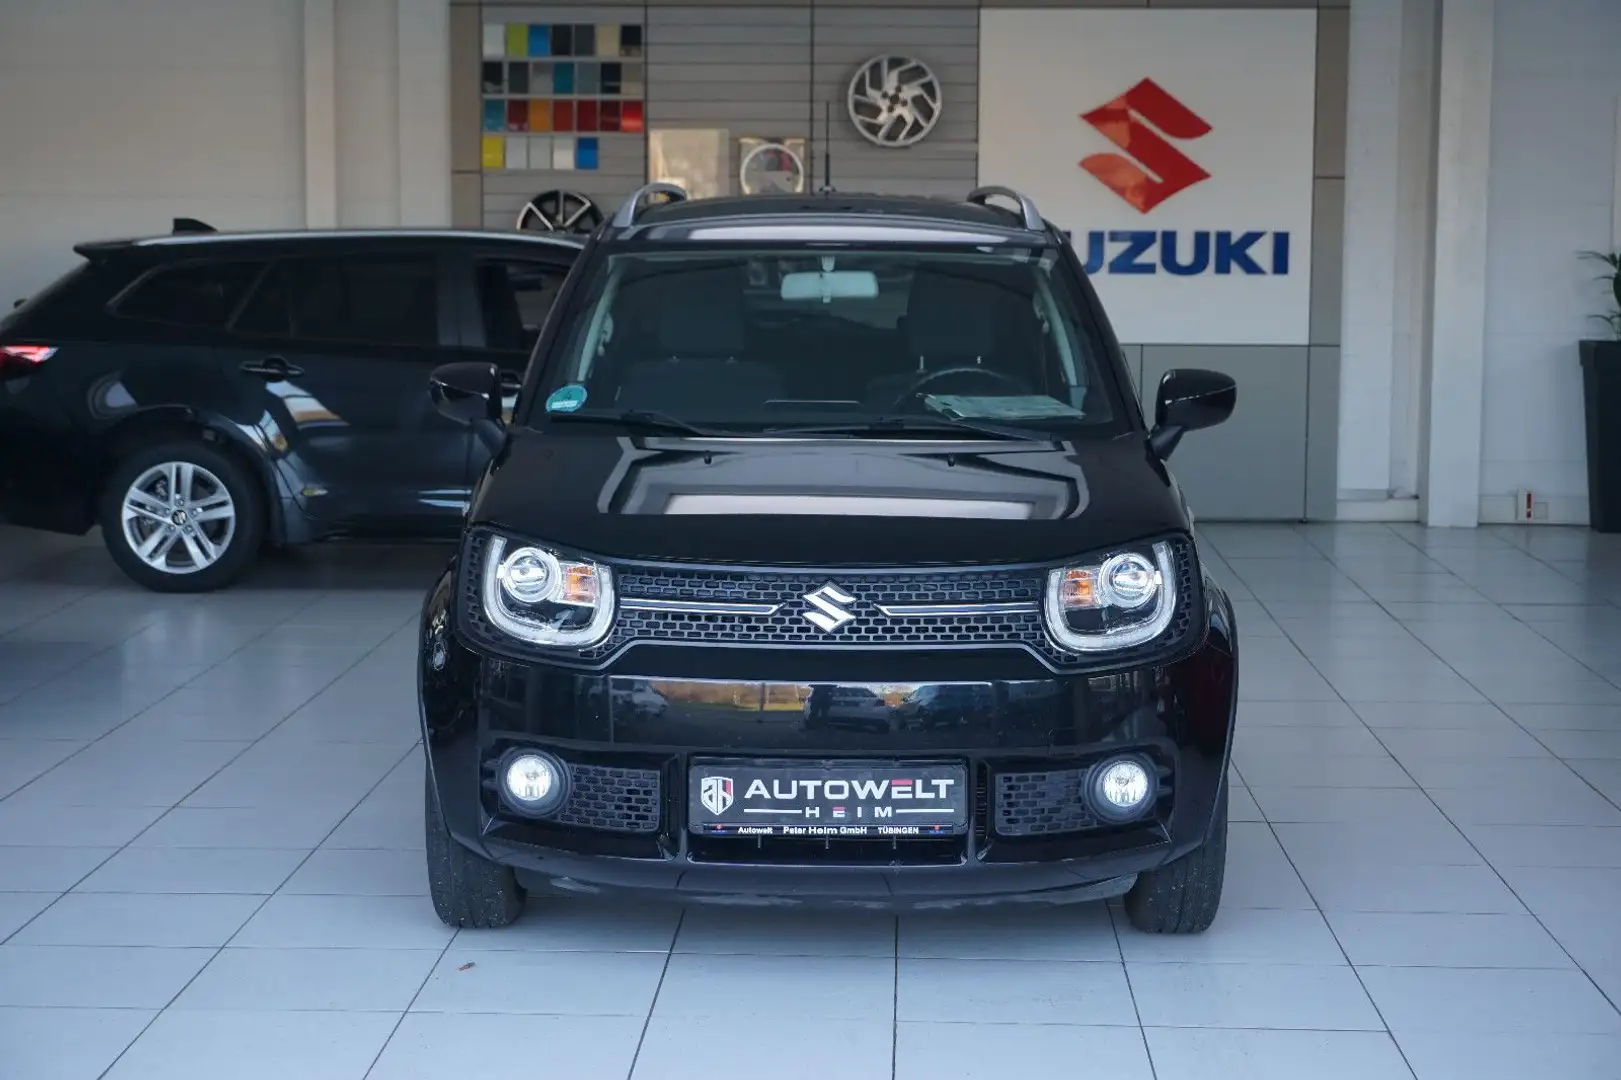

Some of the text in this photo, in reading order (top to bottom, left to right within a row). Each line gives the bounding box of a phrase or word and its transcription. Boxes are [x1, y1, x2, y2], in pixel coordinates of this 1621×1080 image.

[1063, 230, 1290, 276] UZUKI
[744, 779, 955, 800] AUTOWELT
[805, 806, 893, 818] HEIM
[737, 826, 773, 834] Autowelt
[839, 826, 868, 834] GmbH
[877, 825, 919, 835] TÜBINGEN
